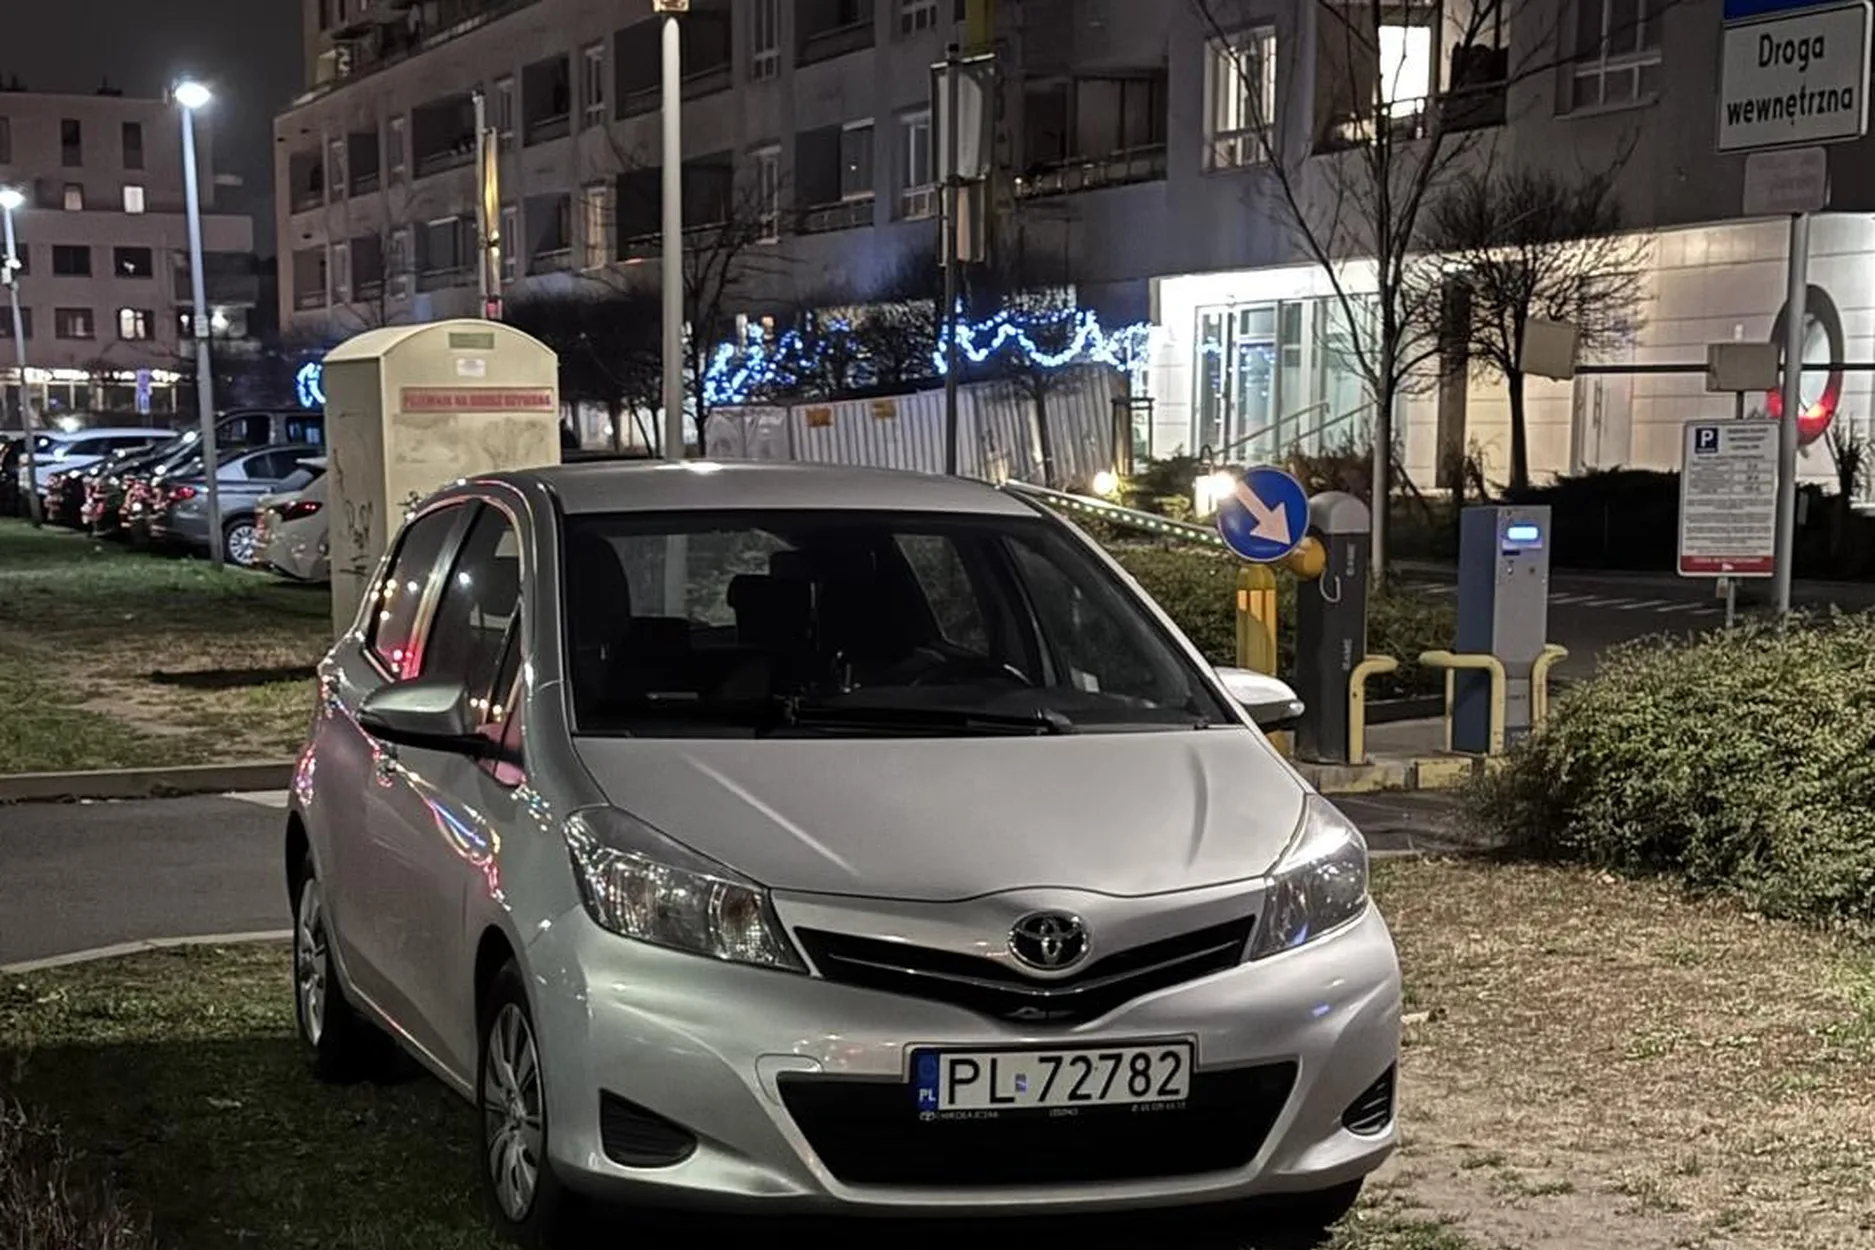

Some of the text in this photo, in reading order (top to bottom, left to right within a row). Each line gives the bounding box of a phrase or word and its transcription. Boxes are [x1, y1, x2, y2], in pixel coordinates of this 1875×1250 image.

[1758, 32, 1825, 72] Droga
[1727, 86, 1853, 126] wewnętrzna
[1701, 430, 1714, 447] P
[919, 1088, 936, 1102] PL
[948, 1050, 1182, 1105] PL 72782
